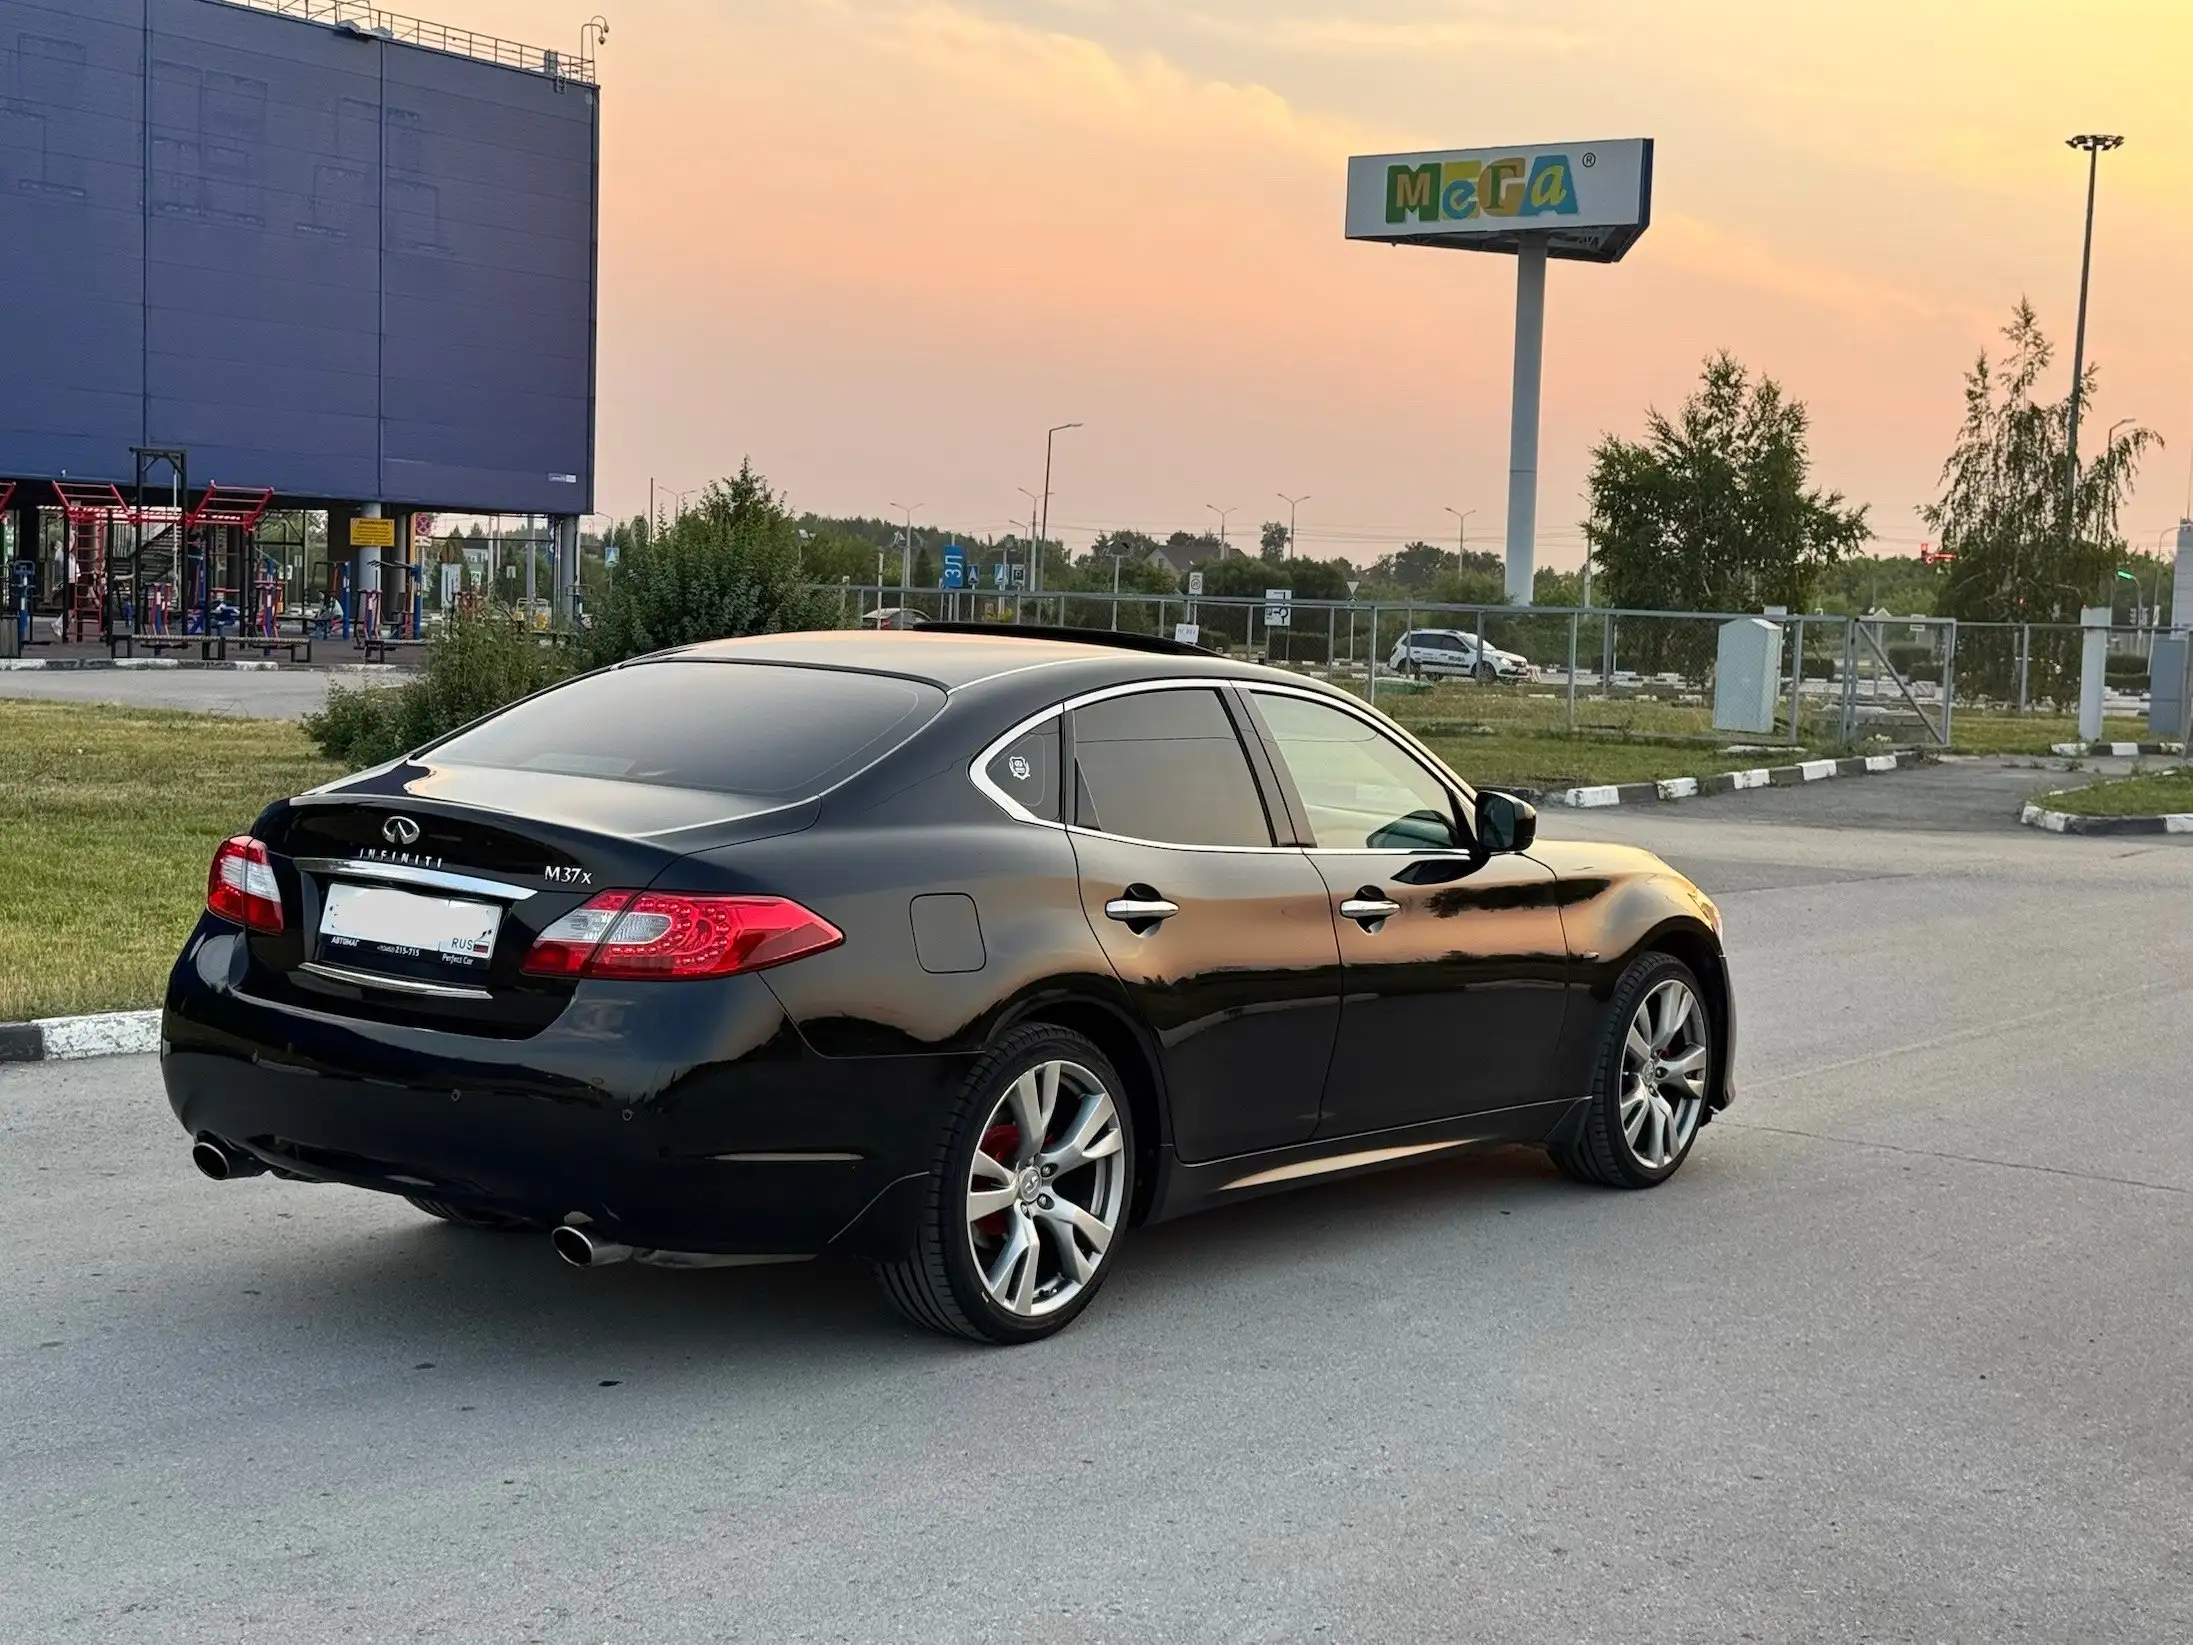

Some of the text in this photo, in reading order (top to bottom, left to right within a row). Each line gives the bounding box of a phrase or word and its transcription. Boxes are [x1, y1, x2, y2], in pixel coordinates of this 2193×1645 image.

[359, 848, 442, 868] INFINITI
[544, 865, 593, 885] M37x
[451, 937, 474, 951] RUS
[441, 953, 474, 965] Perfect Car
